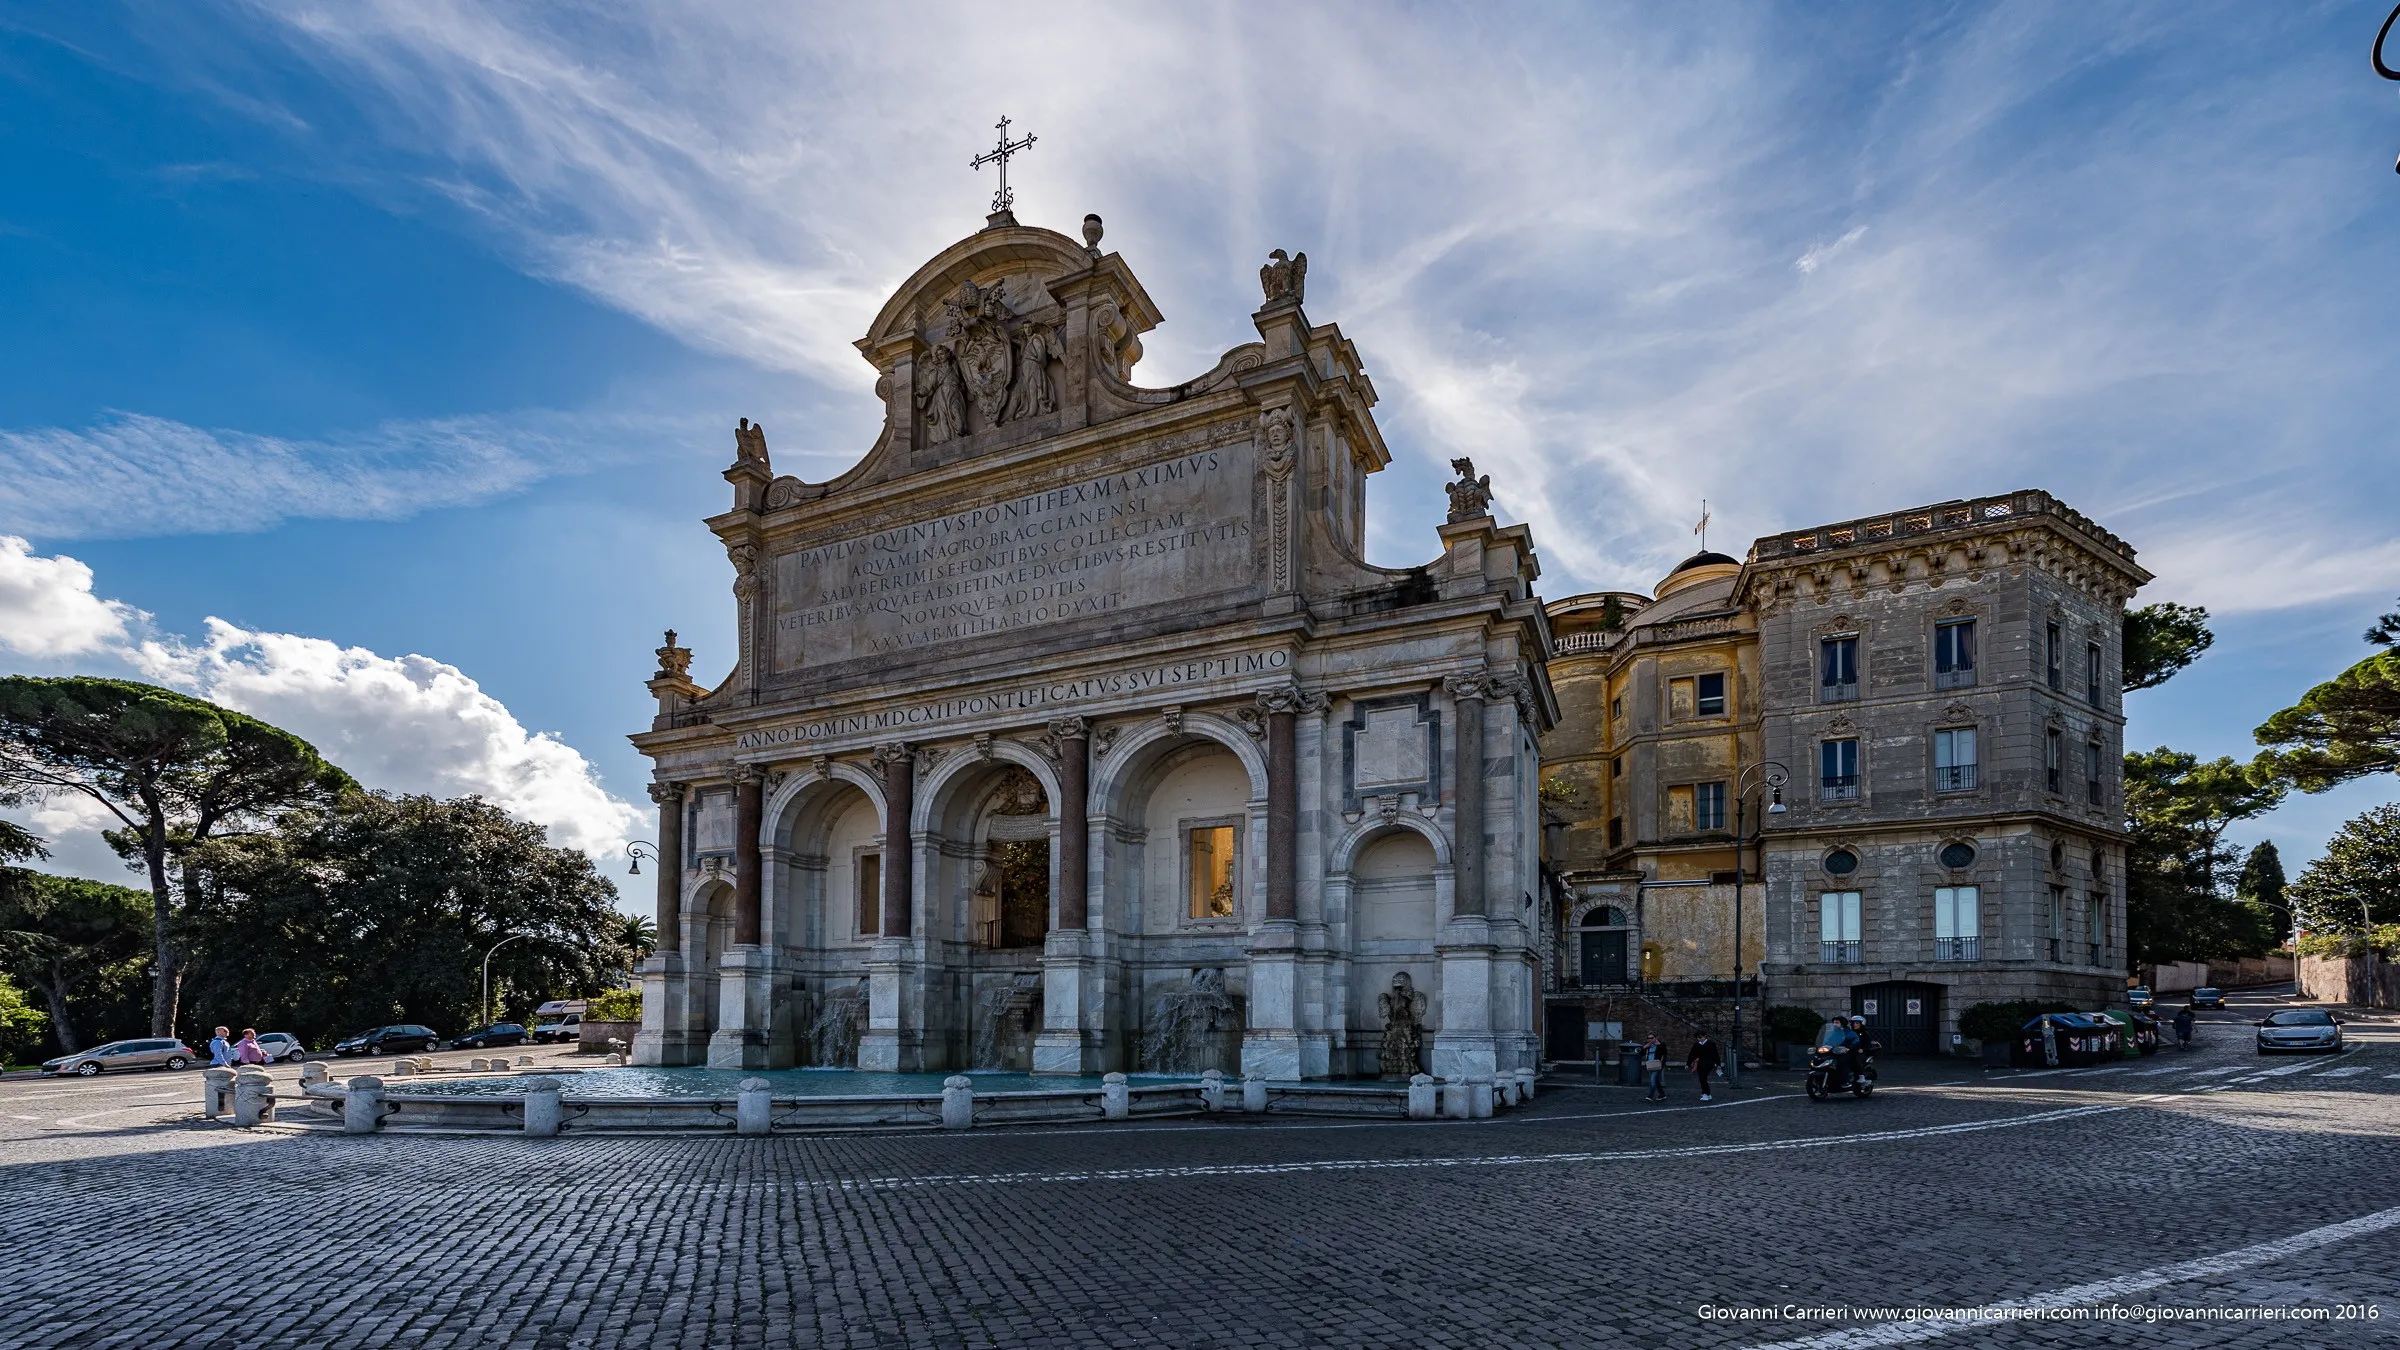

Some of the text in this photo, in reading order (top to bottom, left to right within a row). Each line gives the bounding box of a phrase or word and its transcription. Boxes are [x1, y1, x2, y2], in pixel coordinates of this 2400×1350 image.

[800, 452, 1219, 569] PAVLVS QVINTVS PONTIFEX MAXIMVS
[851, 497, 1147, 578] AQVAM IN AGRO BRACCIANENSI
[778, 520, 1250, 631] VETERIBVS AQVAE ALSIETINAE DVCTIBVS RESTITVTIS
[821, 511, 1185, 604] SALVBERRIMIS E FONTIBVS COLLECTAM
[900, 577, 1085, 627] NOVISQVE ADDITIS
[871, 592, 1121, 652] XXXV AB MILLIARIO DVXIT
[738, 650, 1287, 749] ANNO DOMINI MDCXII PONTIFICATVS SVI SEPTIMO
